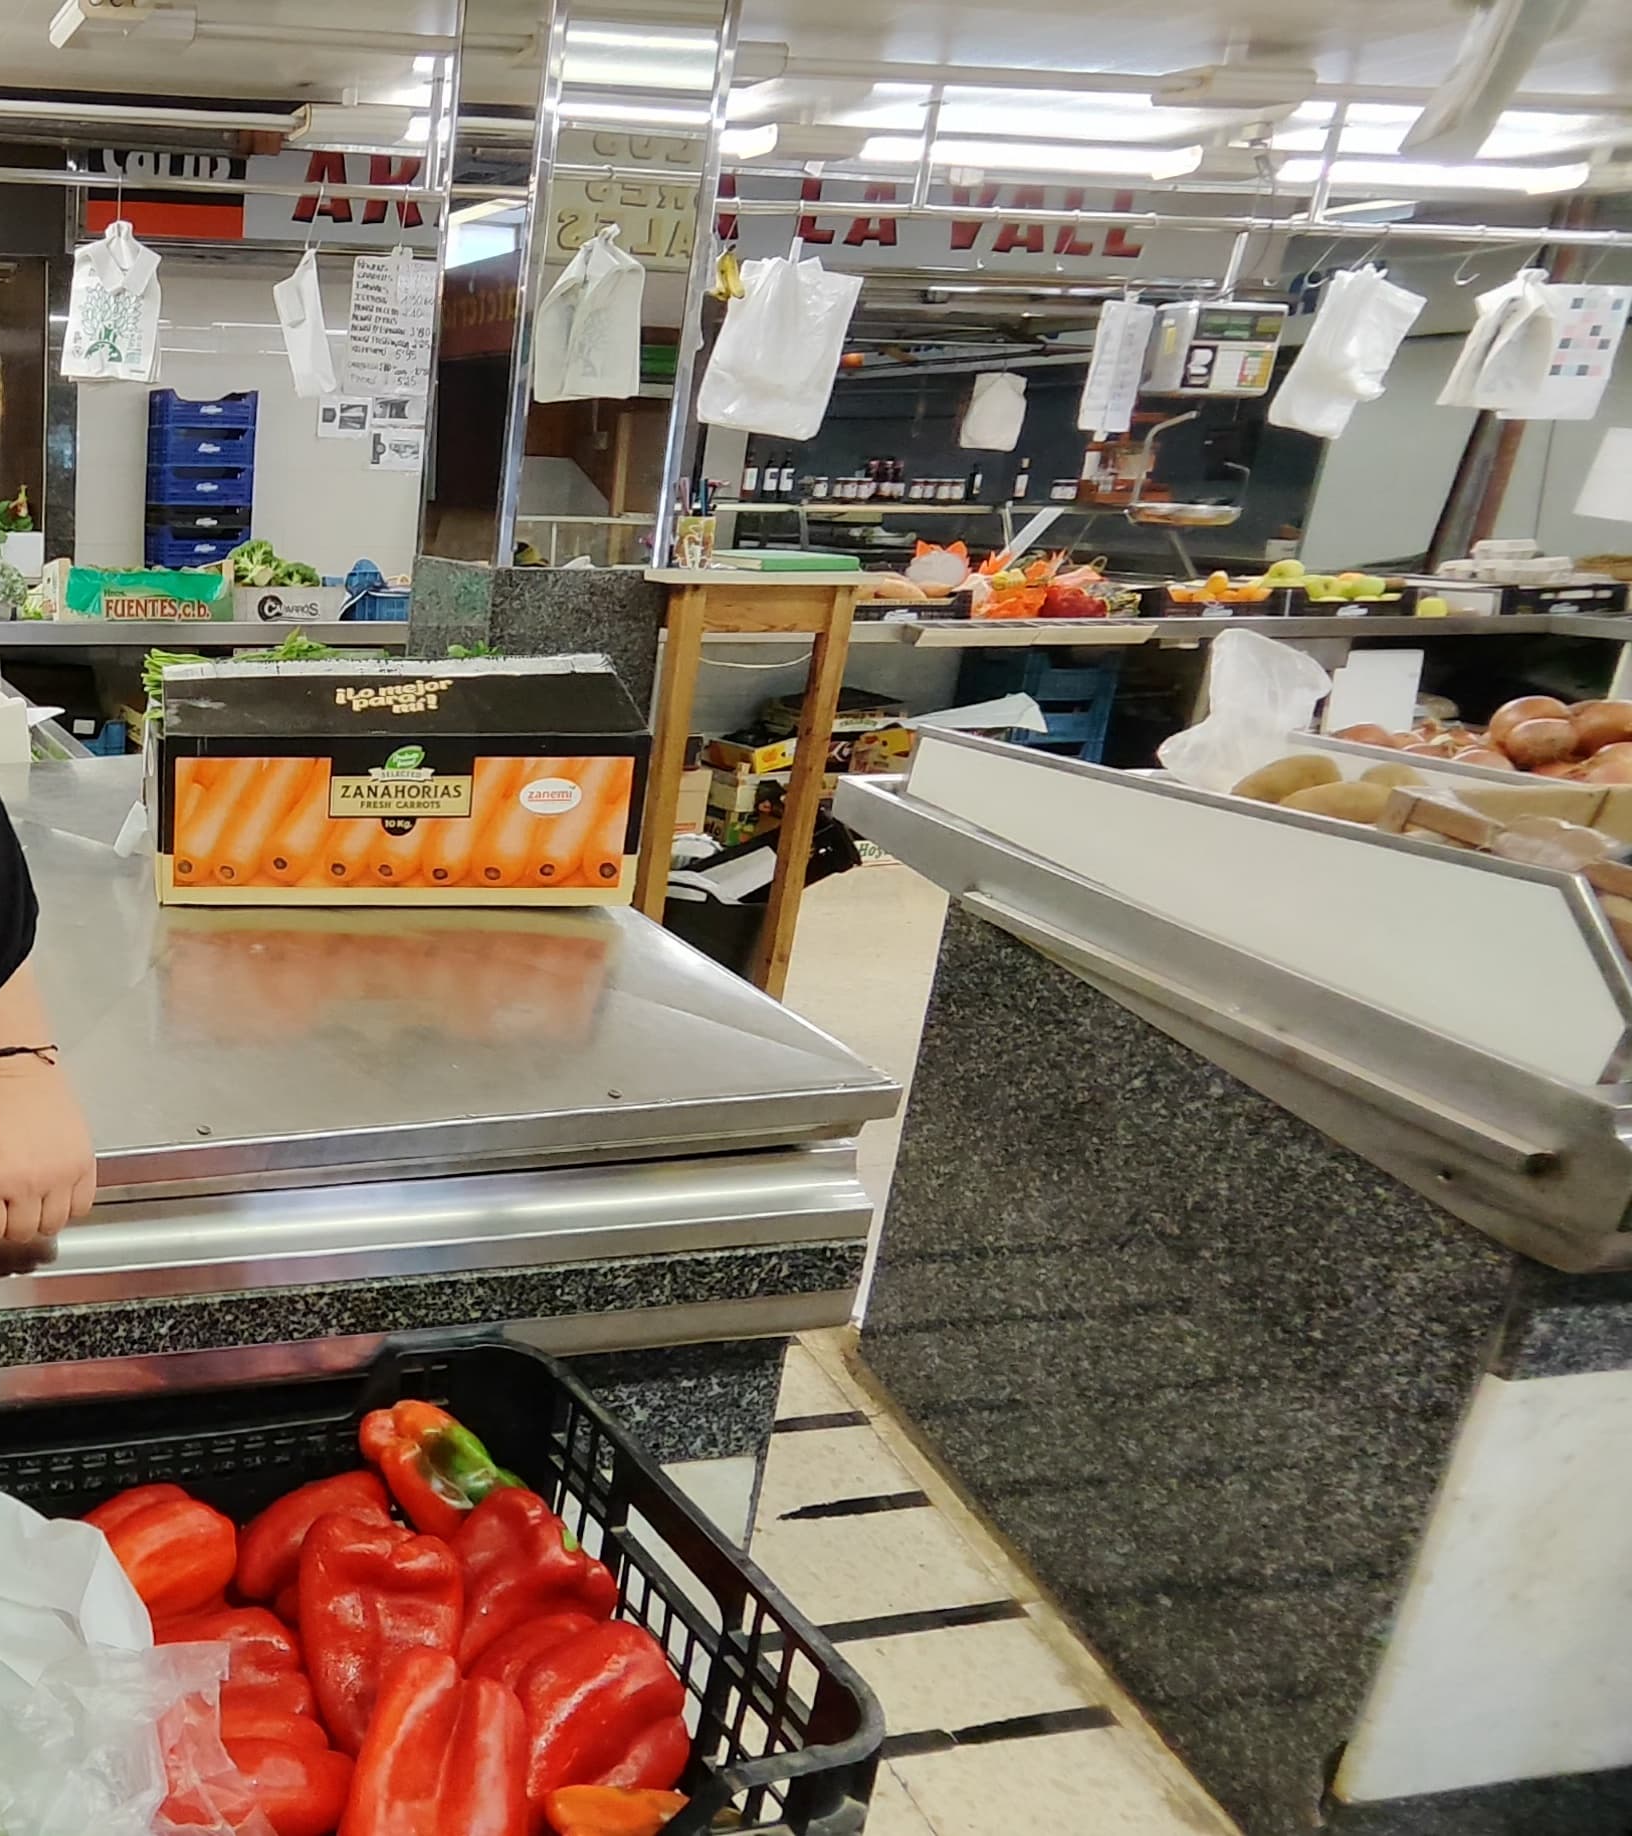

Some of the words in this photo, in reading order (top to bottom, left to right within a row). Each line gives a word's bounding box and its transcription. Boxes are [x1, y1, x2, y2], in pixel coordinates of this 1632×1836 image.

[291, 151, 441, 229] AR
[797, 177, 898, 248] LA
[950, 182, 1146, 259] VALL
[378, 679, 454, 697] mejor
[351, 693, 417, 712] para
[340, 784, 463, 800] ZANAHORIAS
[527, 789, 573, 800] zanemi
[359, 801, 392, 809] FRESH
[396, 801, 441, 809] CARROTS
[384, 819, 396, 829] 10
